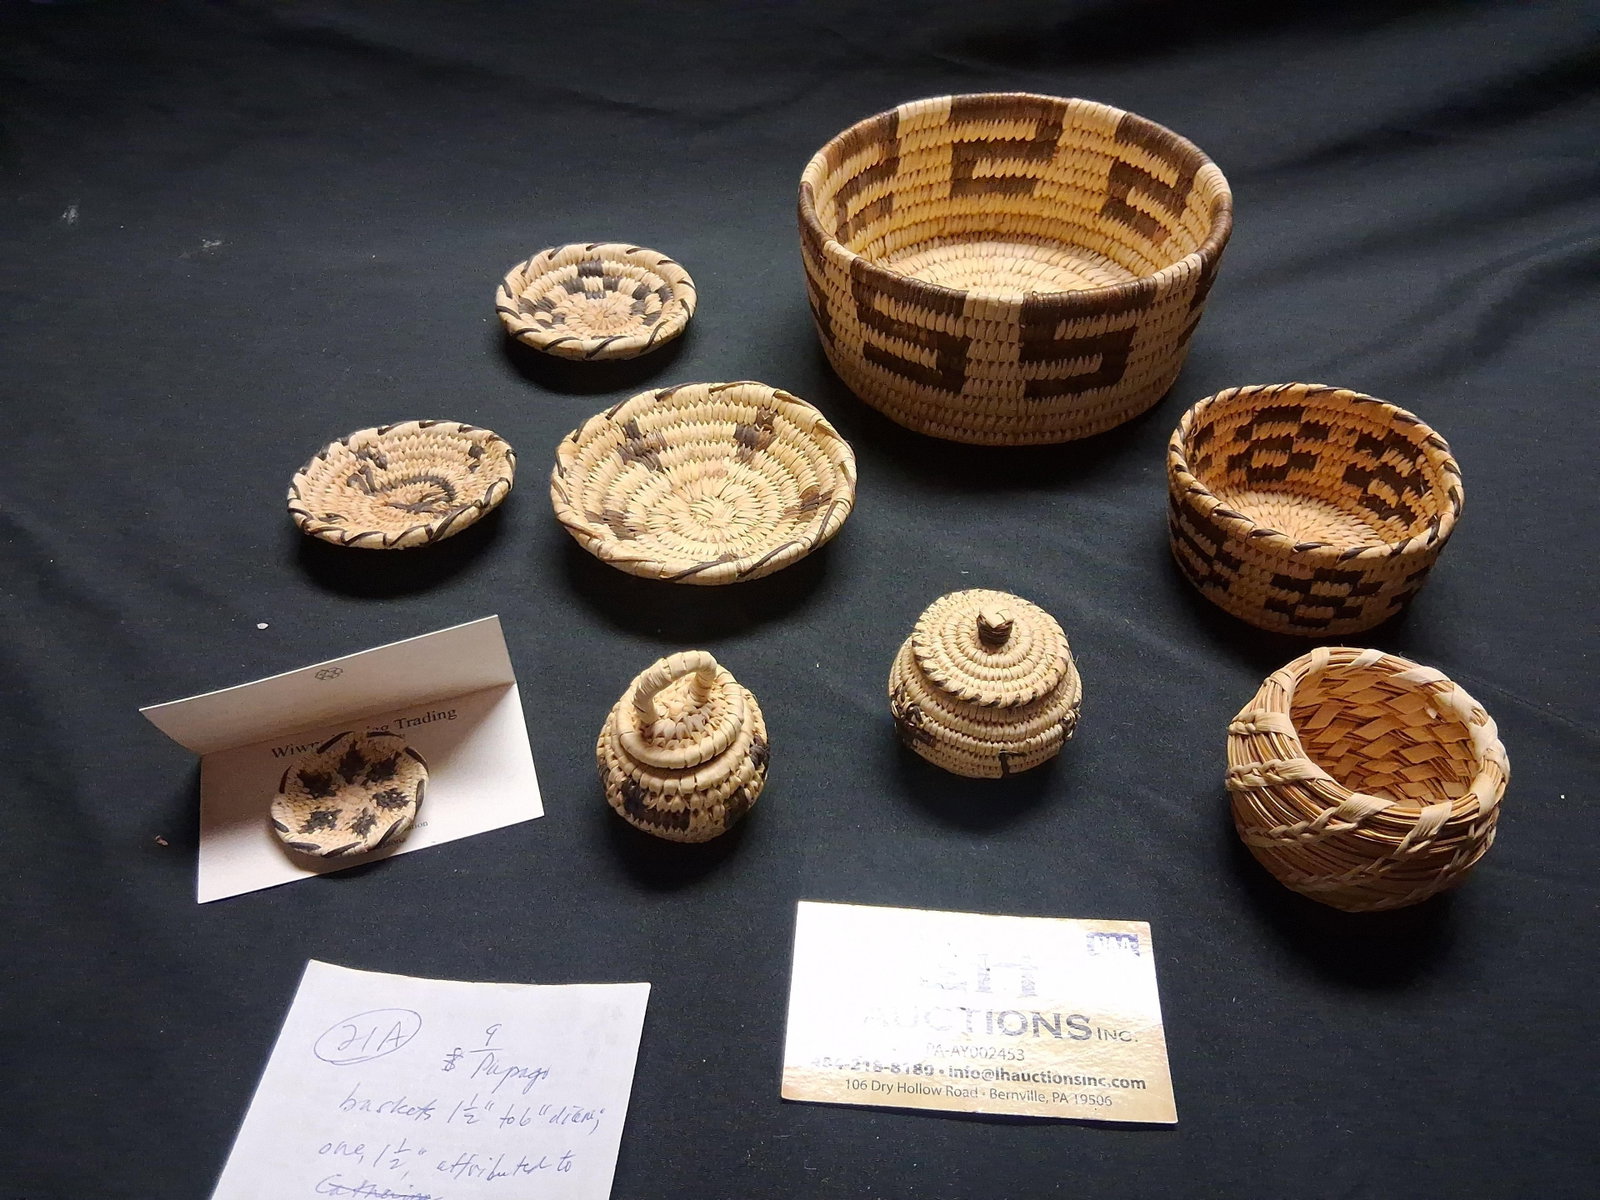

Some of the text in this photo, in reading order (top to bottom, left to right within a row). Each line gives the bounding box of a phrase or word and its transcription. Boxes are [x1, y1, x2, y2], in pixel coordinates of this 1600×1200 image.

[393, 708, 458, 730] Trading
[337, 1020, 408, 1052] 21A
[1096, 1026, 1139, 1043] INC.
[948, 1064, 1147, 1090] info@lhauctionsinc.com
[845, 1078, 1113, 1108] 106 Dry Hollow Road Bernville, PA 19506
[556, 1149, 576, 1173] to
